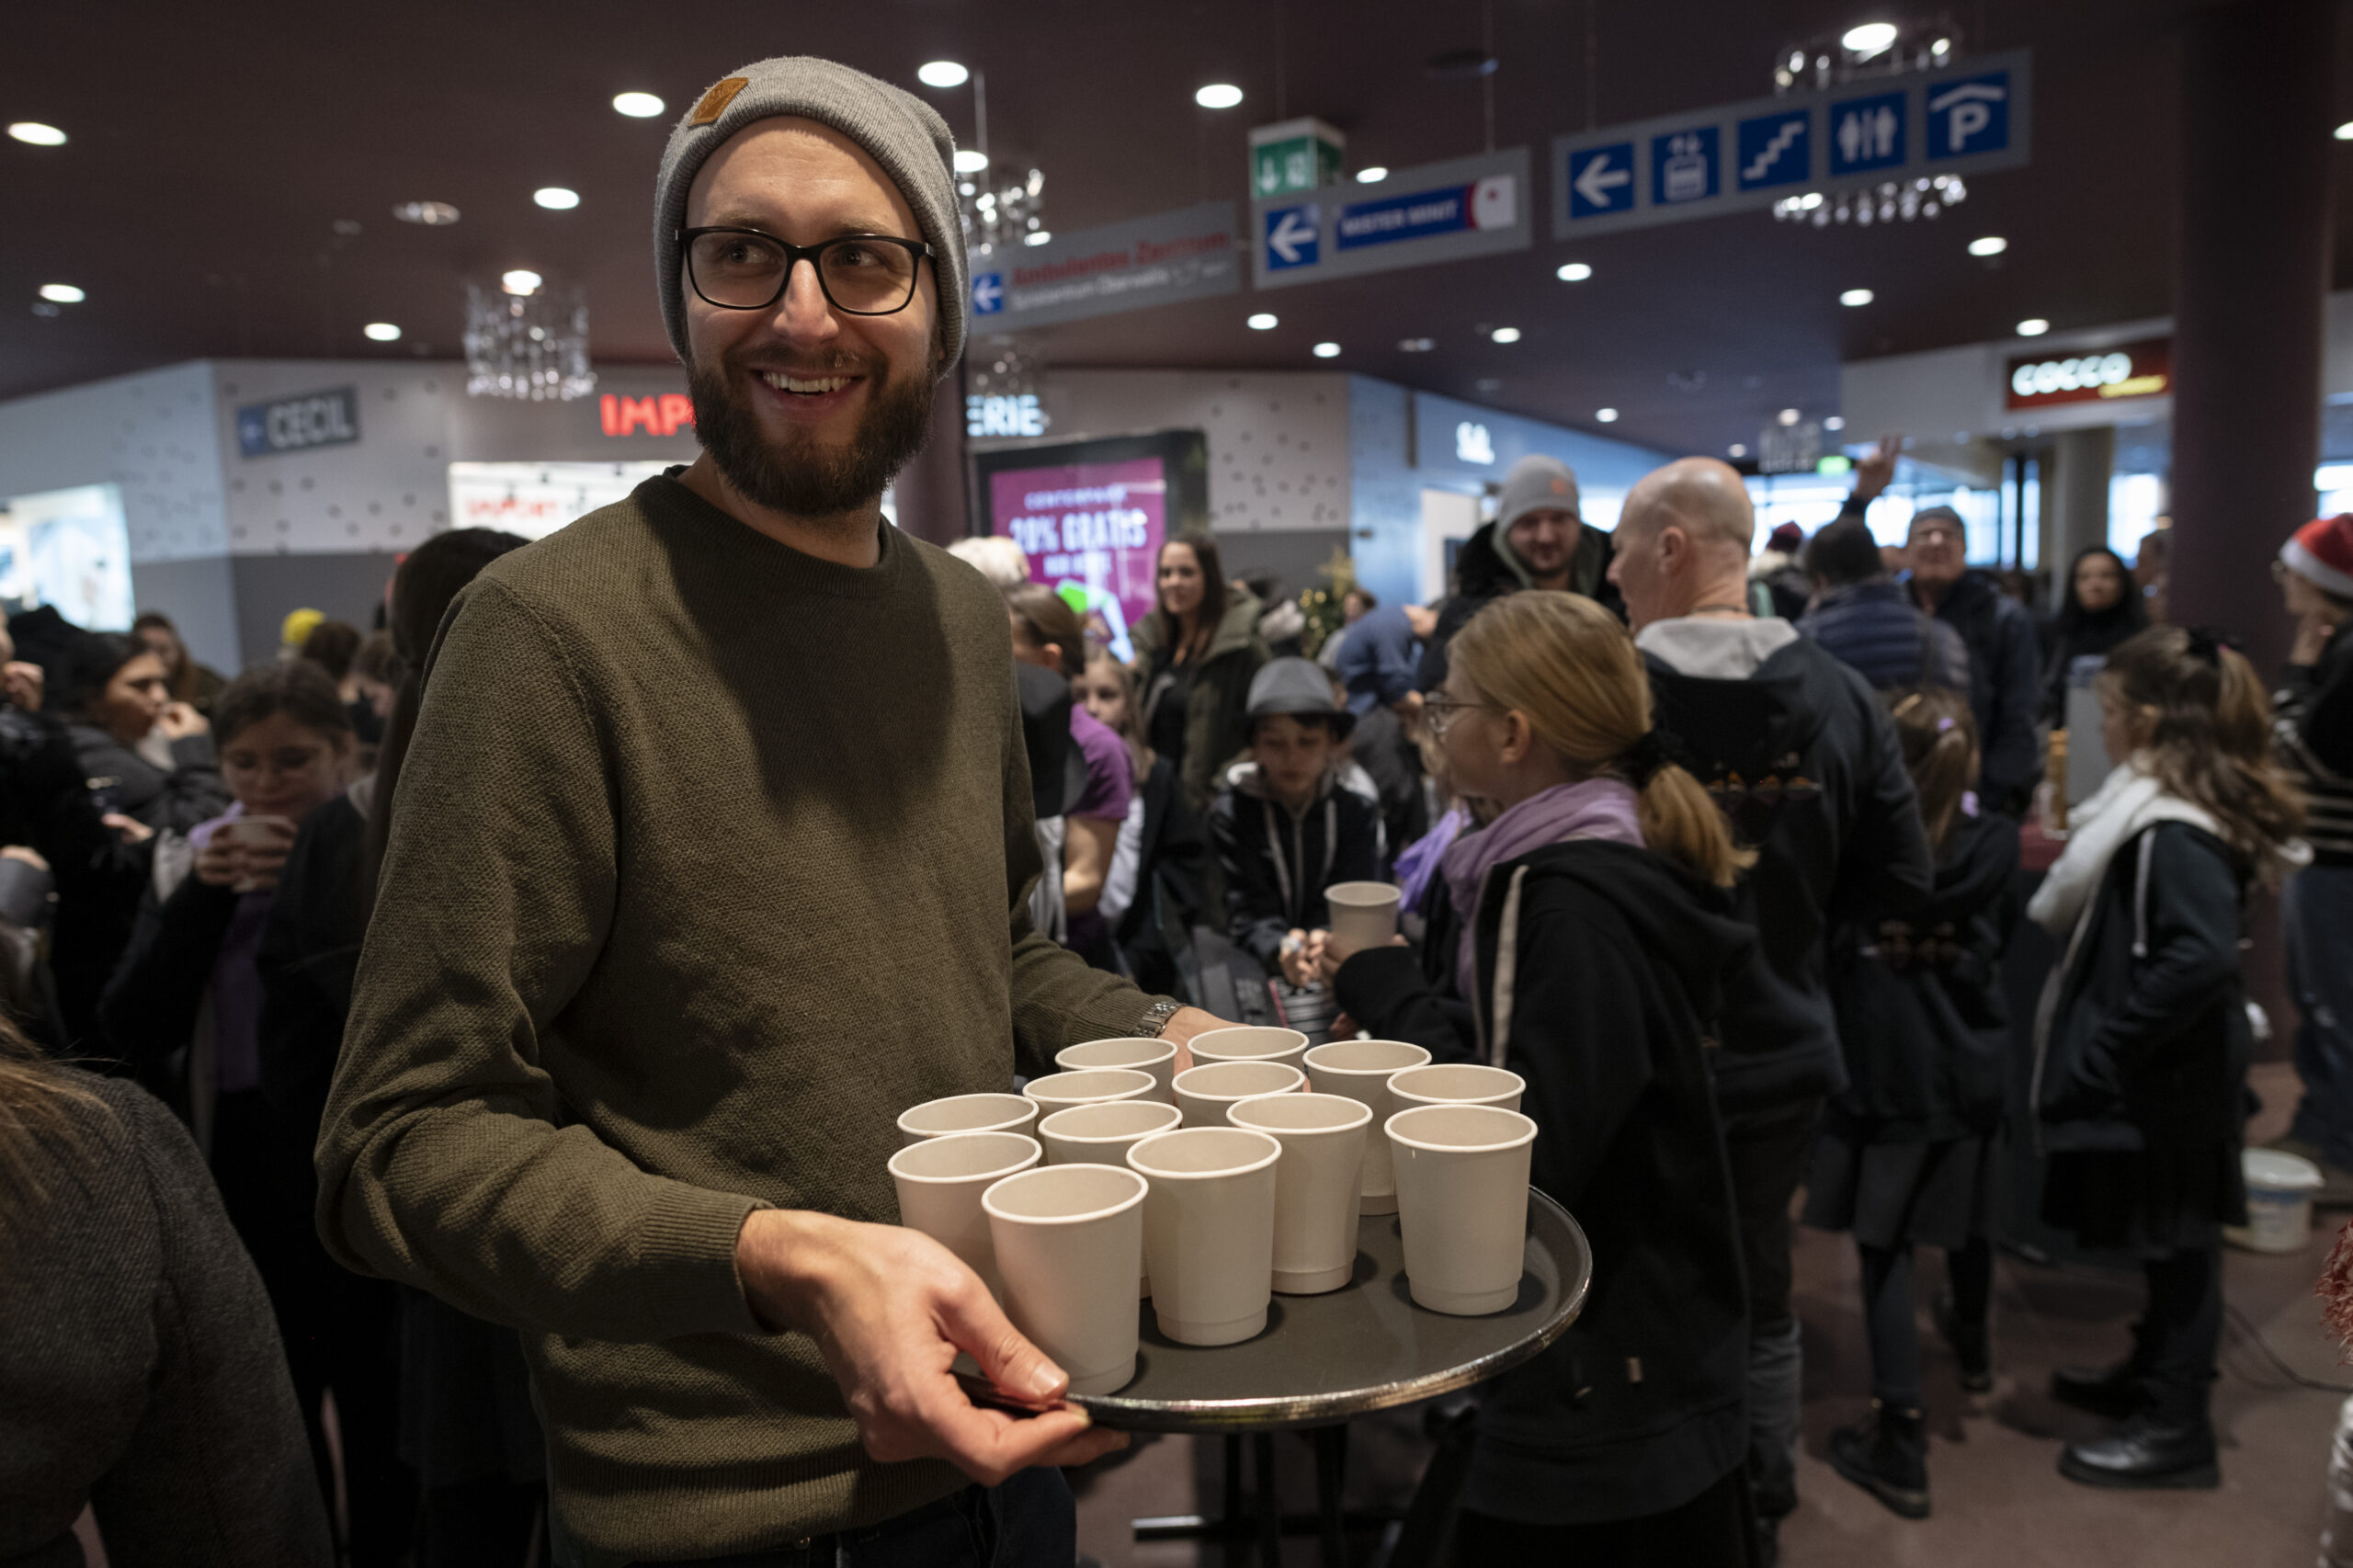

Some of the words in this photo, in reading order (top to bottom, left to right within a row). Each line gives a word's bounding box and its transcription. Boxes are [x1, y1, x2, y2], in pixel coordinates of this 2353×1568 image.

[1341, 209, 1405, 237] MISTER
[1407, 199, 1459, 225] MINIT
[1135, 232, 1230, 264] Zentrum
[267, 395, 353, 449] CECIL
[599, 392, 697, 437] IMP
